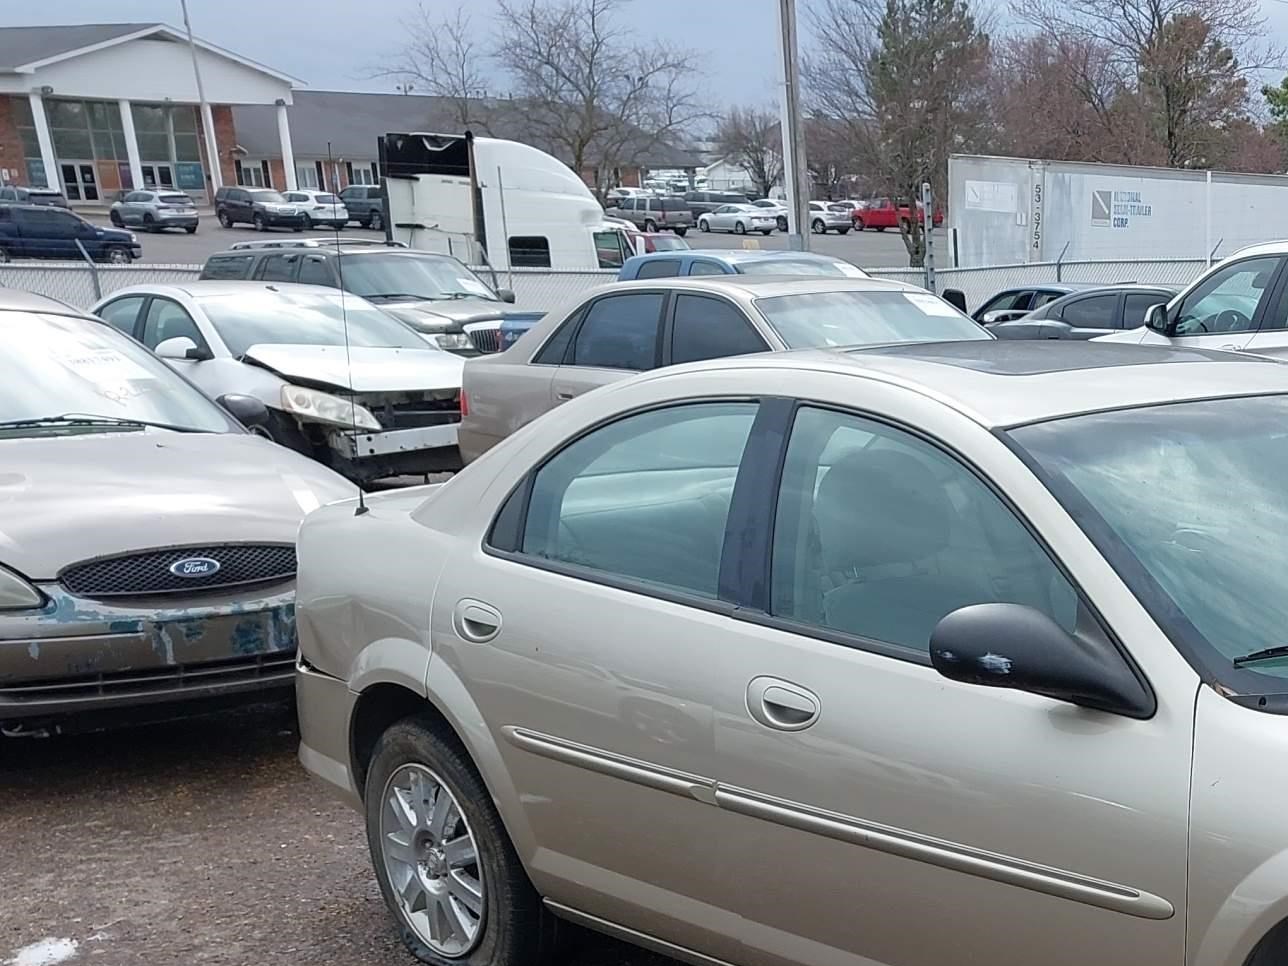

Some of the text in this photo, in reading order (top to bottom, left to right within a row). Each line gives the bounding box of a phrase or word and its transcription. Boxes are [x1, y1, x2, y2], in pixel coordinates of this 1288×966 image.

[1032, 184, 1042, 249] 53-3754
[1113, 217, 1129, 228] CORP.
[183, 561, 209, 574] Ford
